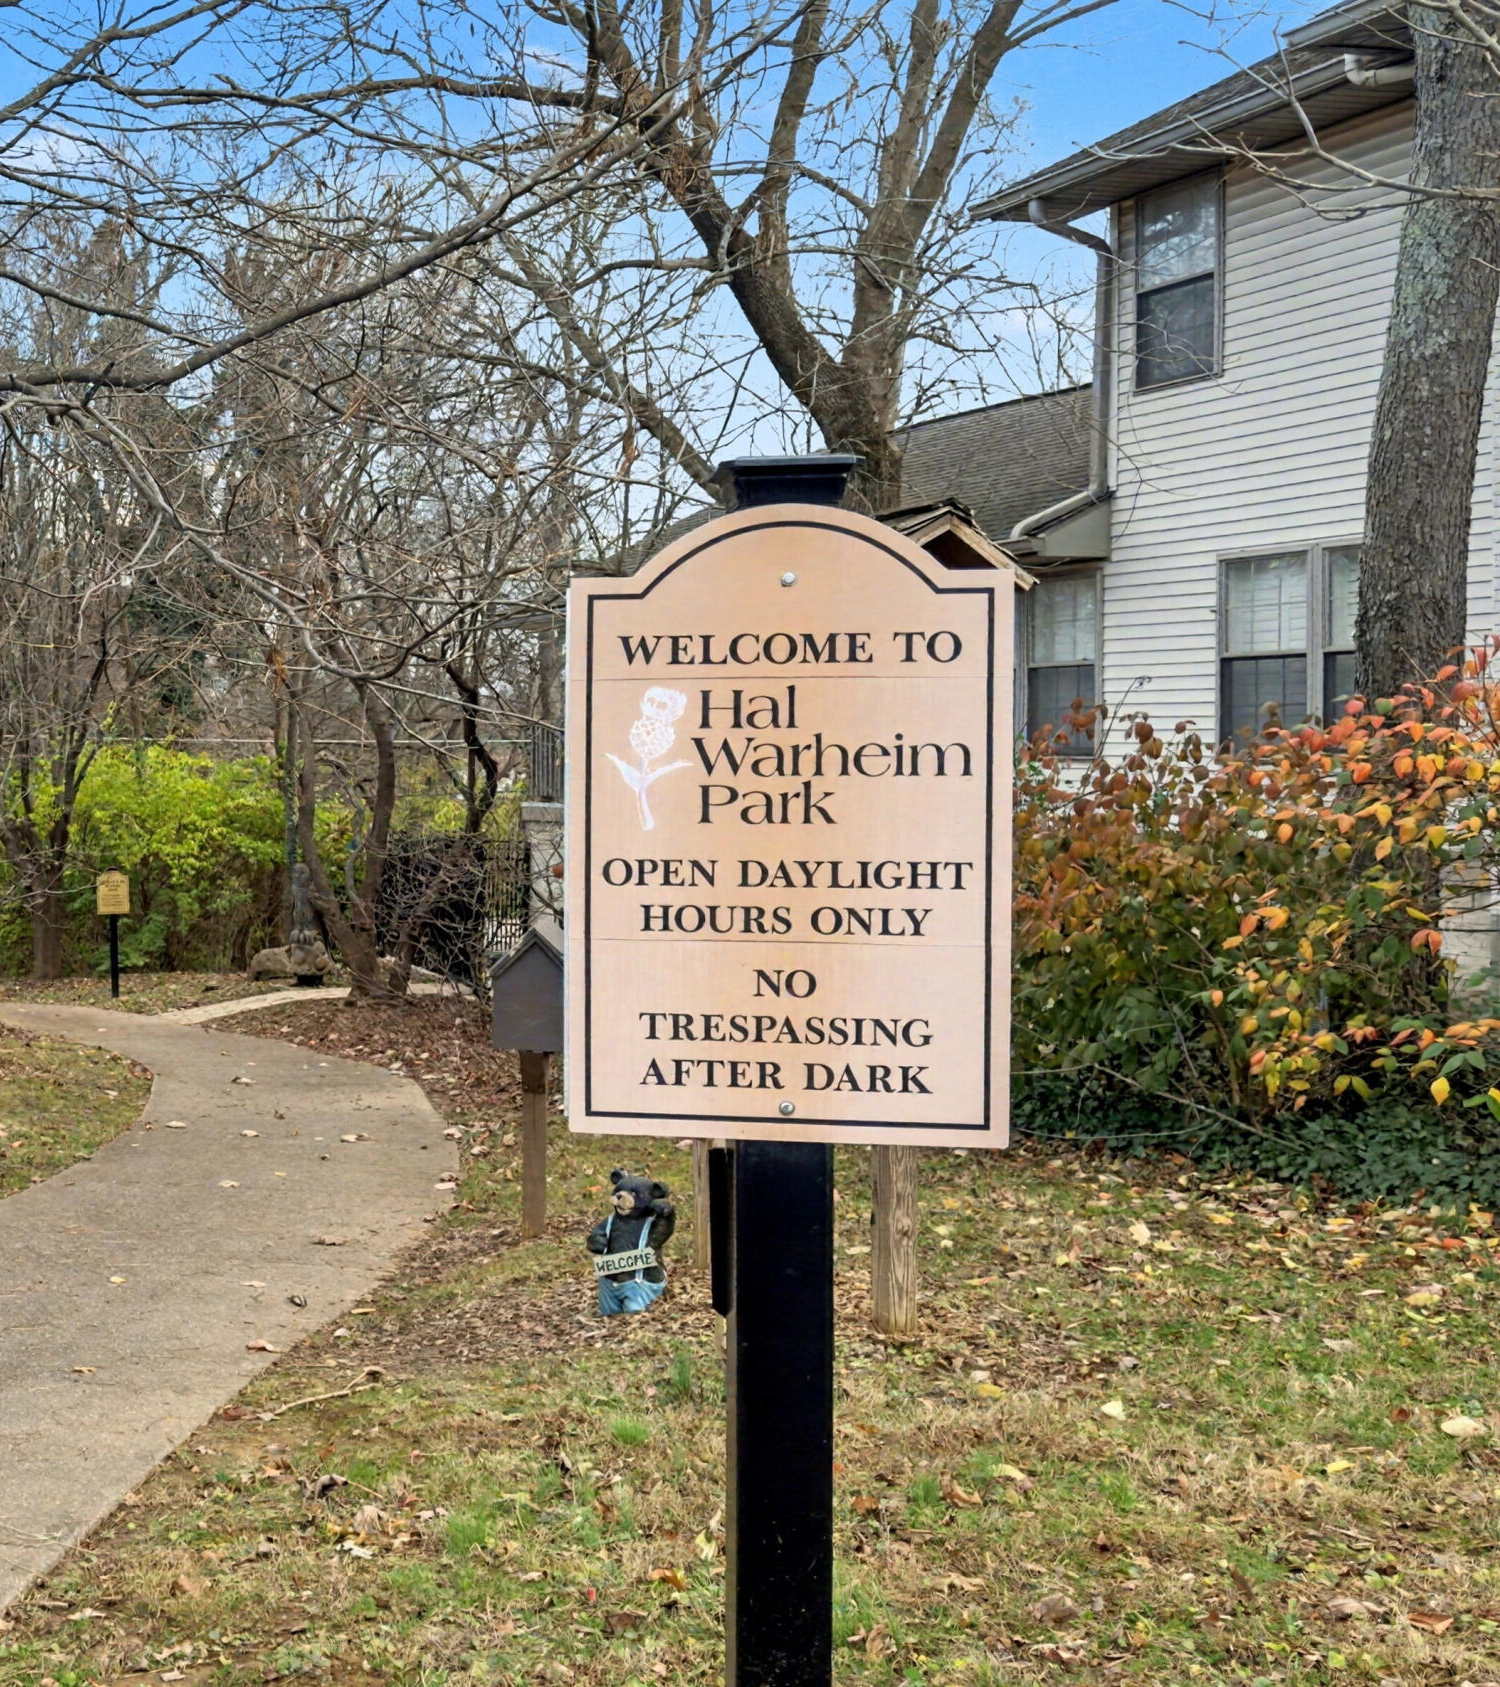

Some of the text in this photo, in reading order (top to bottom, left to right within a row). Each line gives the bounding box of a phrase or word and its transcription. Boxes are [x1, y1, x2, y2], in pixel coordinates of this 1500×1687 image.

[617, 630, 963, 666] WELCOME TO
[699, 684, 798, 730] Hal
[690, 732, 973, 778] Warheim
[698, 780, 837, 825] Park
[602, 857, 973, 890] OPEN DAYLIGHT
[640, 904, 933, 937] HOURS ONLY
[752, 969, 817, 999] NO
[639, 1012, 933, 1048] TRESPASSING
[639, 1058, 933, 1094] AFTER DARK
[596, 1252, 651, 1273] WELCOME
